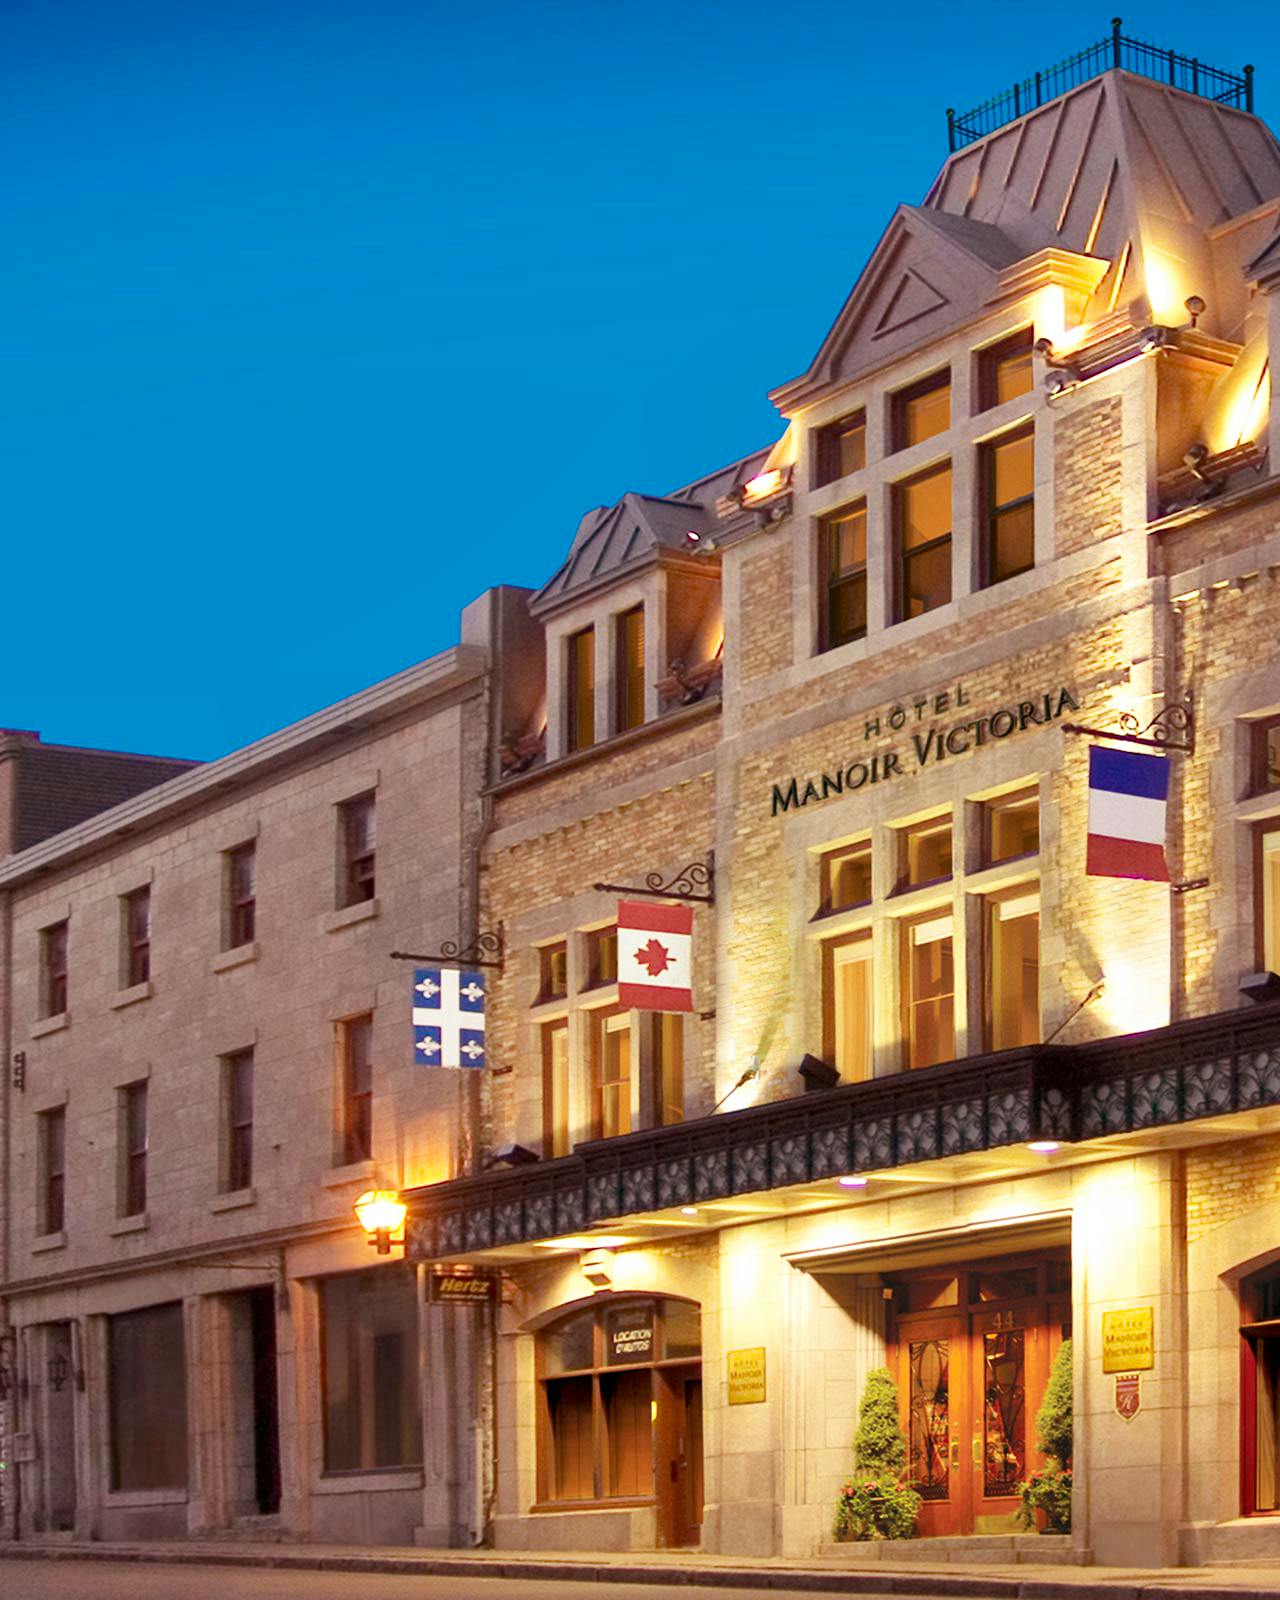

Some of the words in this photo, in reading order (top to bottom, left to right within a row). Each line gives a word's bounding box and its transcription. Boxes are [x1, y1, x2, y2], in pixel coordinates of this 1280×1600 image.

[440, 1278, 490, 1293] Hertz
[993, 1311, 1015, 1328] 44
[613, 1329, 652, 1344] LOCATION
